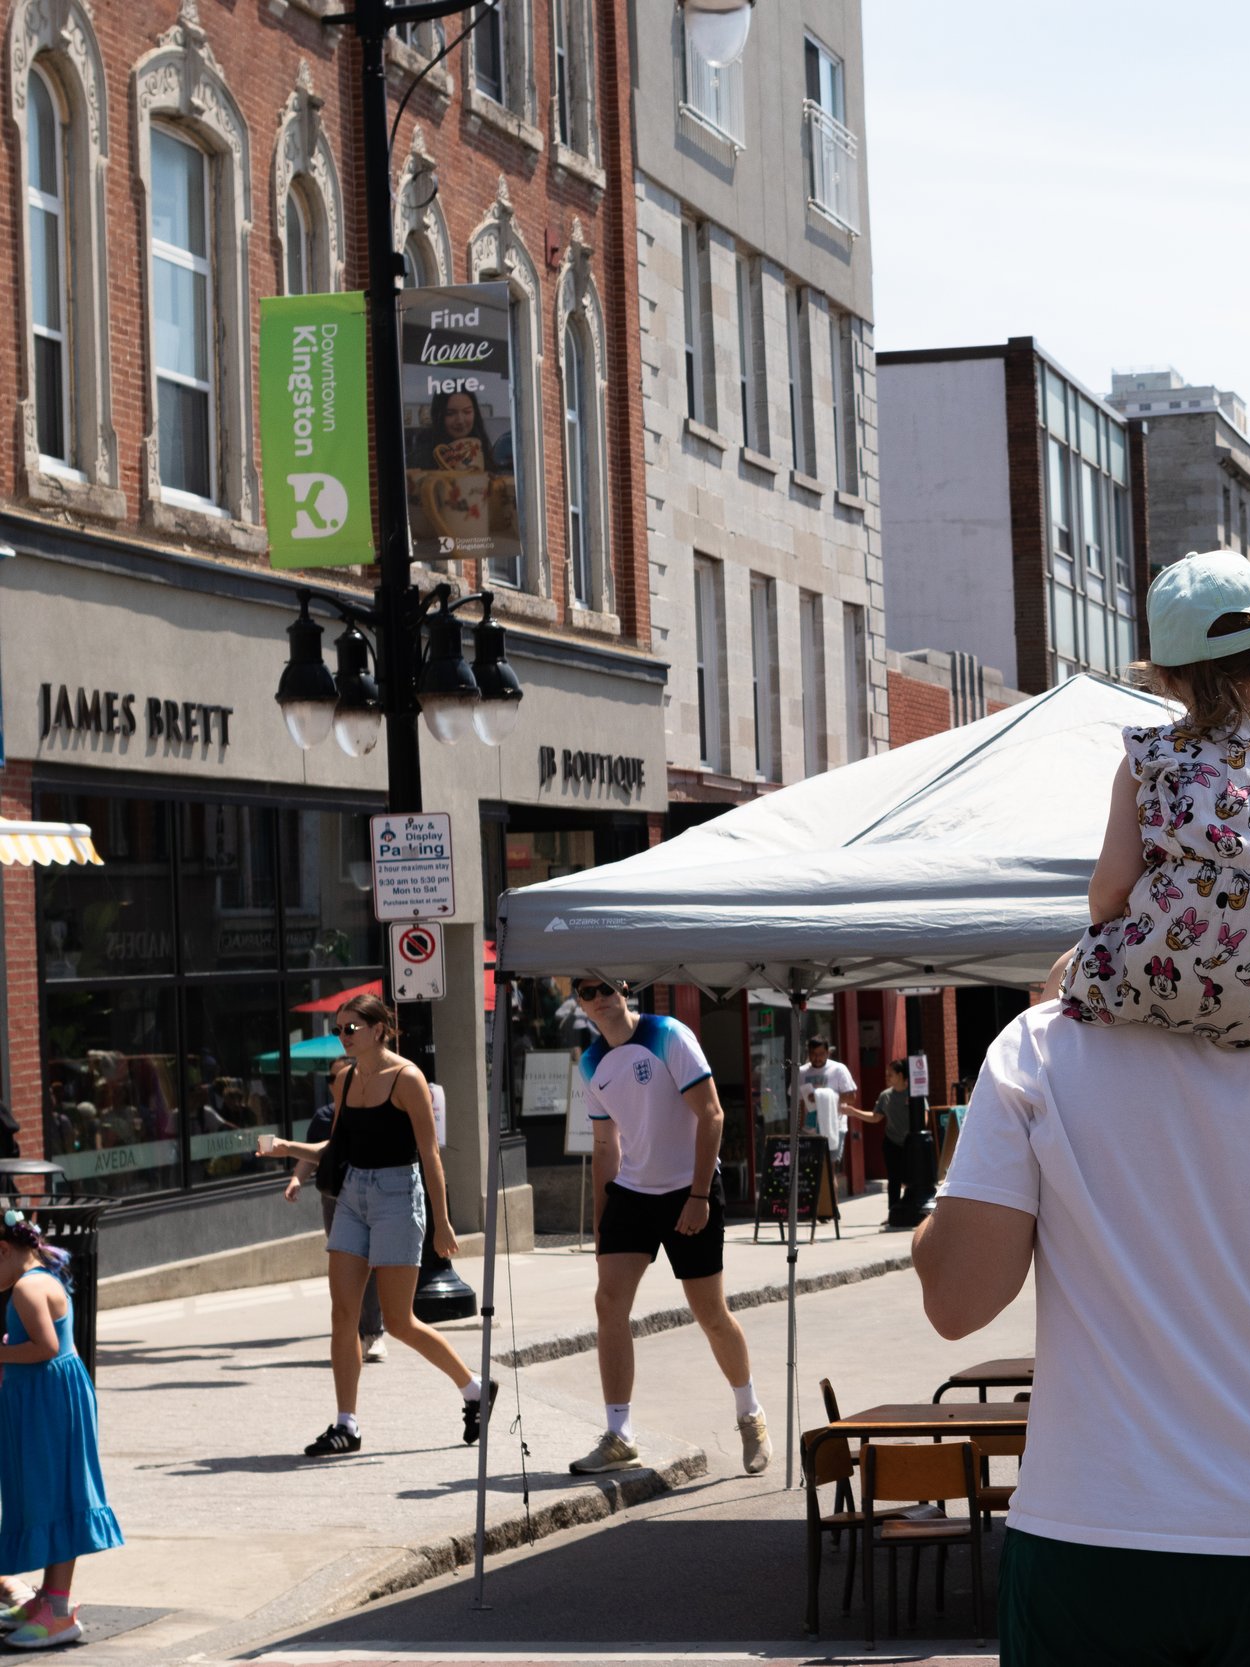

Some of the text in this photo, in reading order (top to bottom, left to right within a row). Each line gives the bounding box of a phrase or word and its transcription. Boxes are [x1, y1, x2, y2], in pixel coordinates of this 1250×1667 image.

[431, 307, 480, 329] Find
[421, 333, 493, 365] home
[321, 323, 338, 432] Downtown
[428, 376, 485, 395] here.
[287, 325, 318, 457] Kingston
[40, 682, 234, 746] JAMES BRETT
[539, 746, 646, 796] JB BOUTIQUE
[405, 822, 424, 832] Pay
[406, 832, 443, 842] Display
[380, 843, 444, 858] Paing
[401, 864, 434, 872] maximum
[379, 878, 395, 886] 9:30
[438, 876, 450, 884] pm
[392, 886, 410, 895] Mon
[95, 1150, 136, 1172] AVEDA
